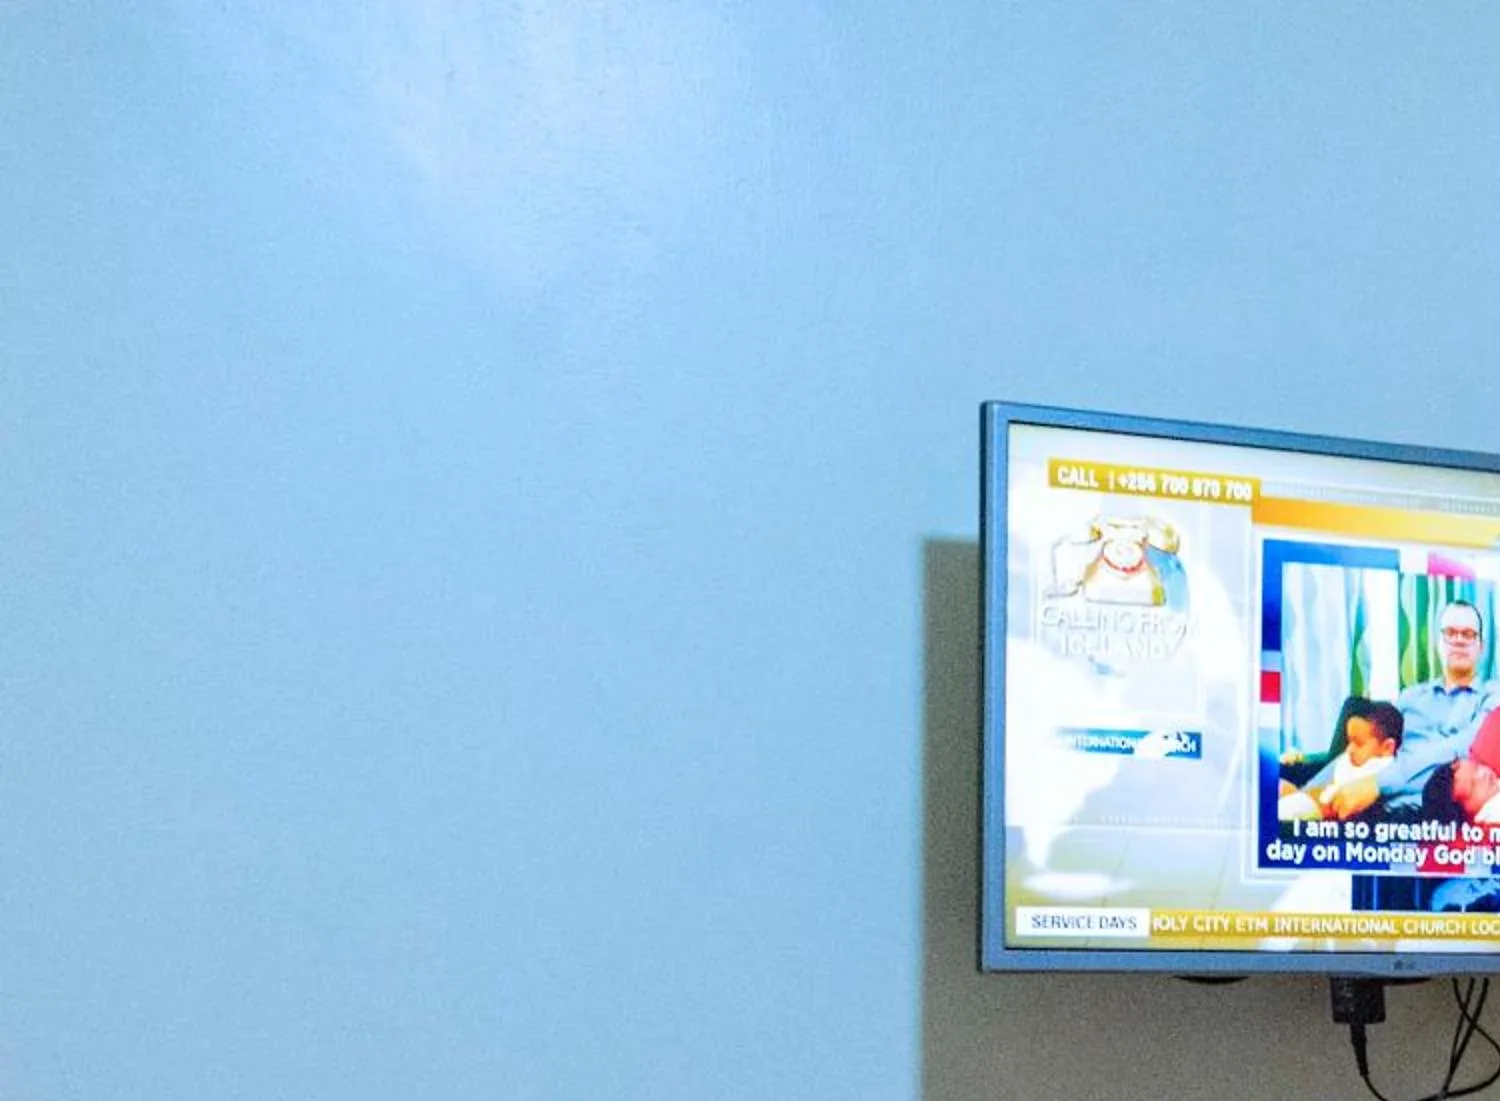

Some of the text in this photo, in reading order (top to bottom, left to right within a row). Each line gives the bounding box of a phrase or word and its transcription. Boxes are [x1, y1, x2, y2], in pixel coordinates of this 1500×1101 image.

[1057, 465, 1099, 488] CALL
[1293, 821, 1300, 838] I
[1305, 822, 1339, 838] am
[1344, 822, 1369, 839] so
[1375, 819, 1457, 843] greatful
[1462, 822, 1485, 841] to
[1266, 839, 1307, 865] day
[1312, 844, 1340, 862] on
[1345, 841, 1428, 867] Monday
[1434, 843, 1474, 865] God
[1031, 914, 1138, 931] SERVICE DAYS
[1193, 914, 1229, 932] CITY
[1274, 916, 1400, 935] INTERNATIONAL
[1404, 918, 1467, 936] CHURCH
